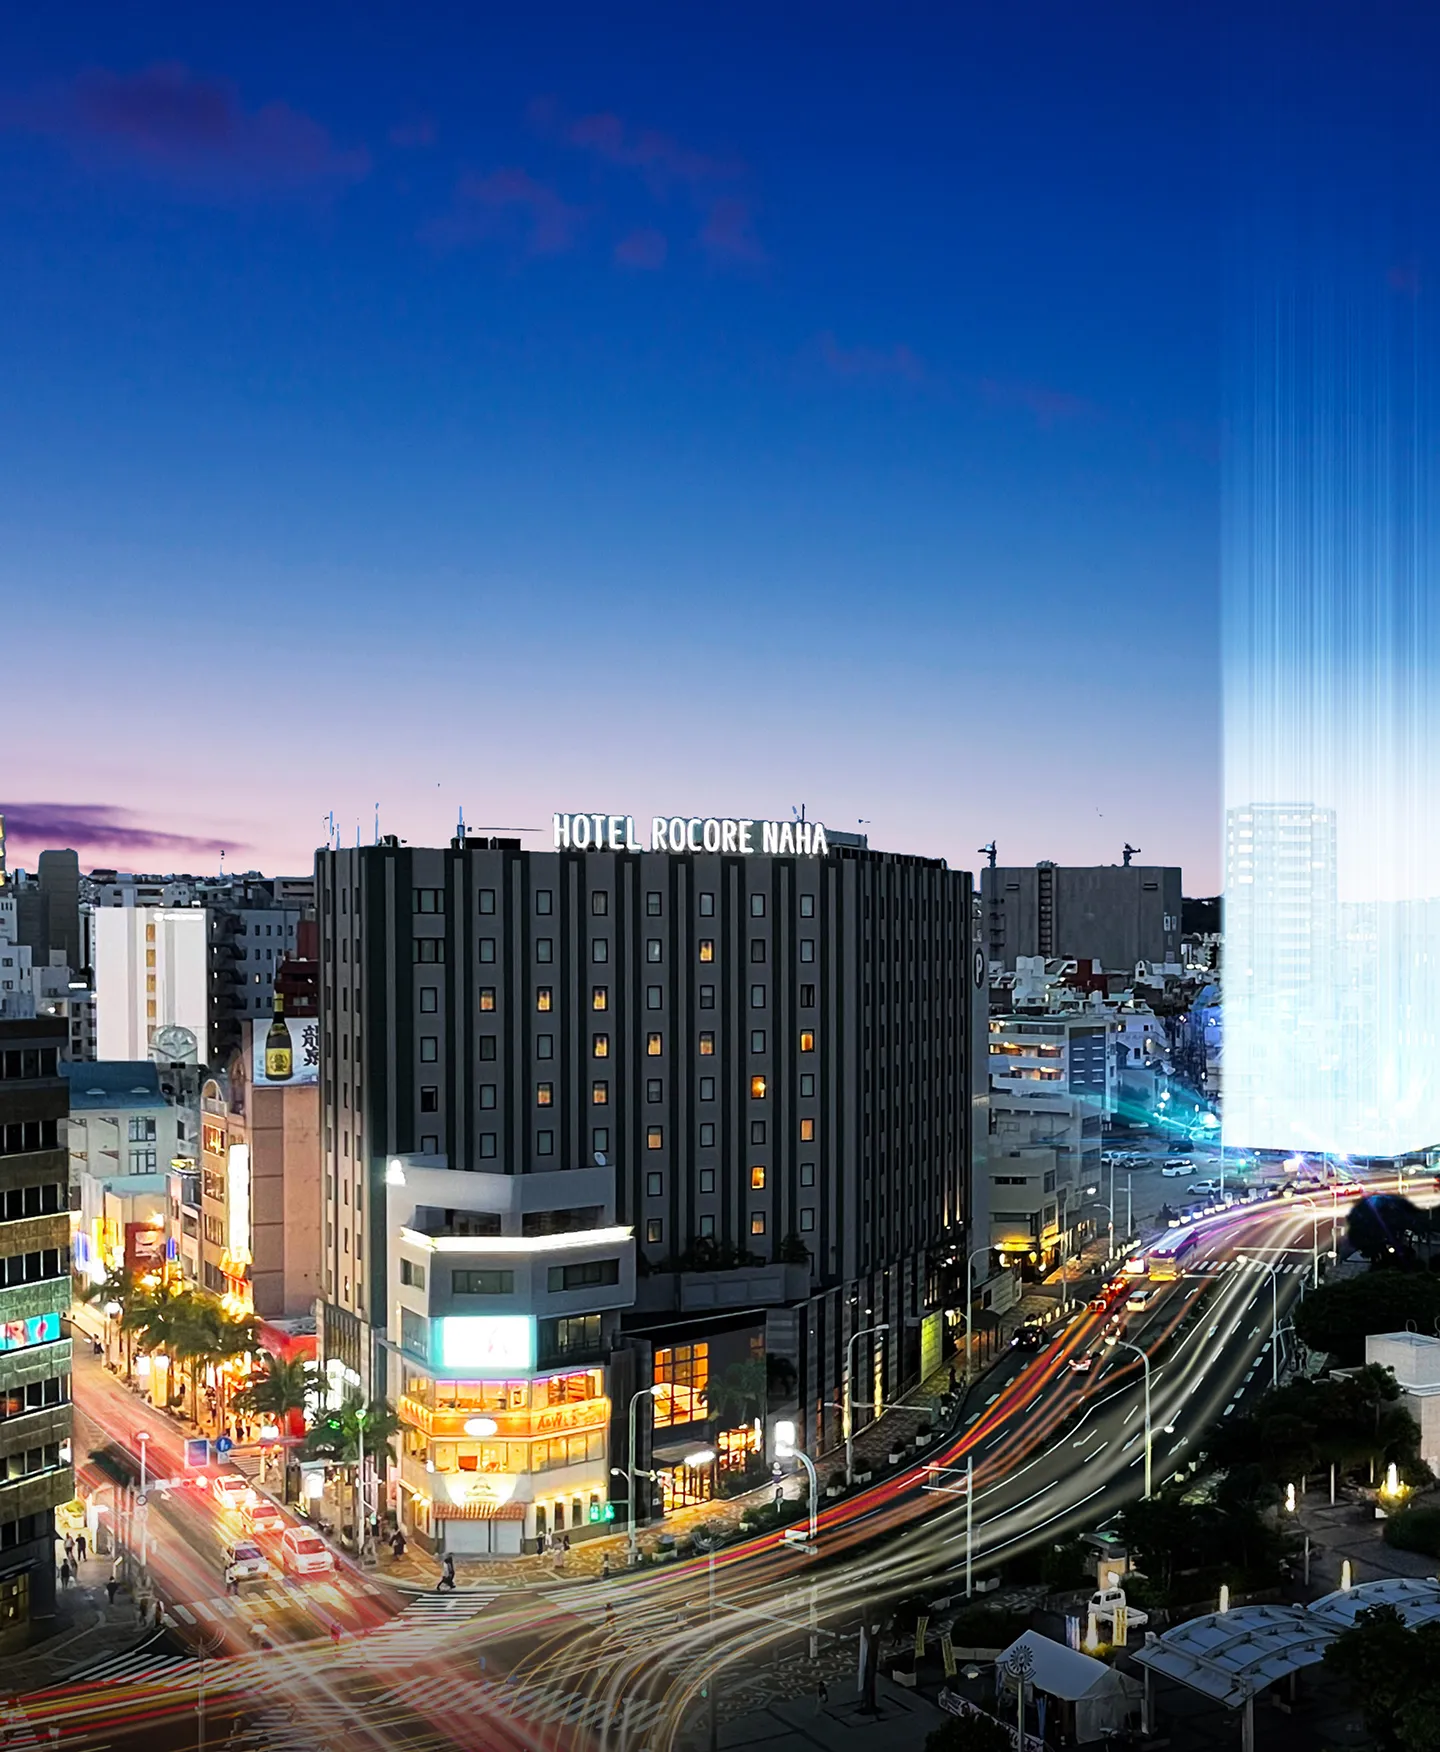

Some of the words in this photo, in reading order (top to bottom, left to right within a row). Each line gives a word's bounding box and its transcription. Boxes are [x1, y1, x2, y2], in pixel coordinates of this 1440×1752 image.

[553, 813, 642, 851] HOTEL
[652, 816, 755, 854] ROCORE
[762, 820, 829, 855] NAHA
[975, 953, 984, 984] P
